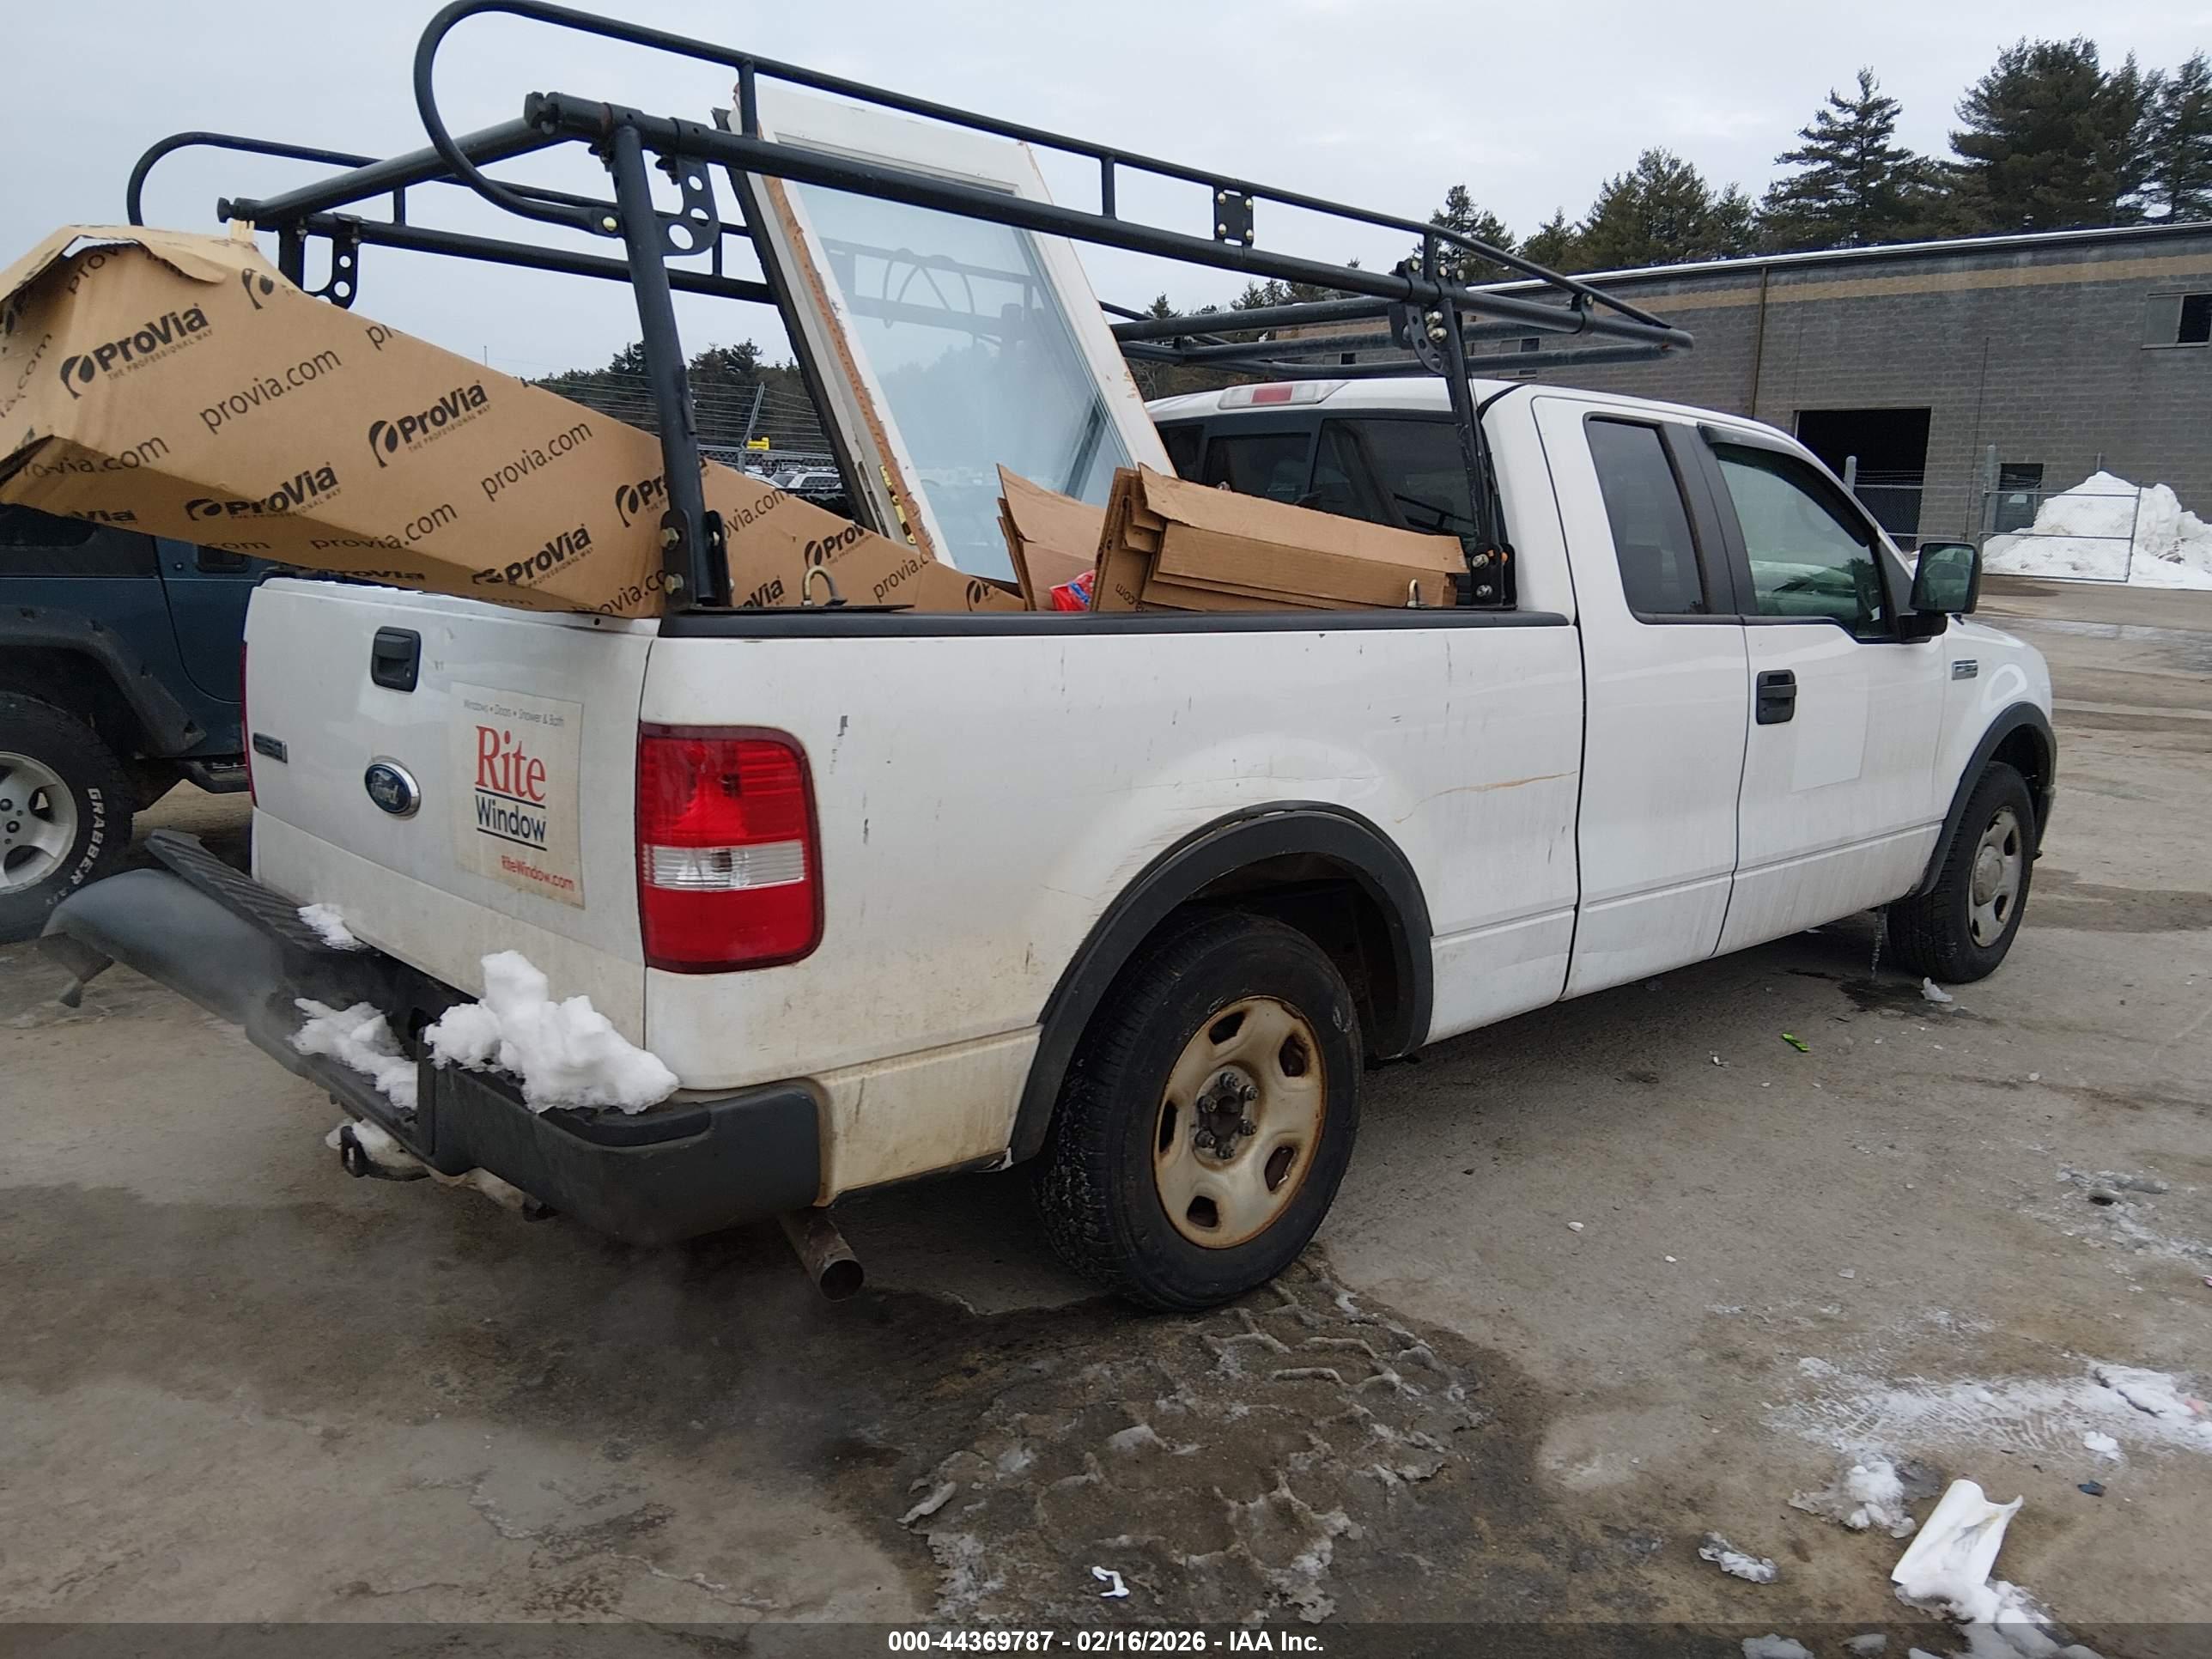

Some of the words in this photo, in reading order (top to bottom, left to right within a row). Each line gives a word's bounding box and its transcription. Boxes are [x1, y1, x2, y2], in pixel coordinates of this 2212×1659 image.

[93, 308, 209, 372] ProVia
[199, 349, 342, 434] provia.com
[397, 385, 488, 444] ProVia
[225, 466, 338, 515] ProVia
[481, 422, 592, 501] provia.com
[310, 502, 458, 550] provia.com
[505, 527, 592, 586] ProVia
[476, 726, 546, 802] Rite
[70, 787, 106, 885] GRABBER
[475, 795, 547, 843] Window
